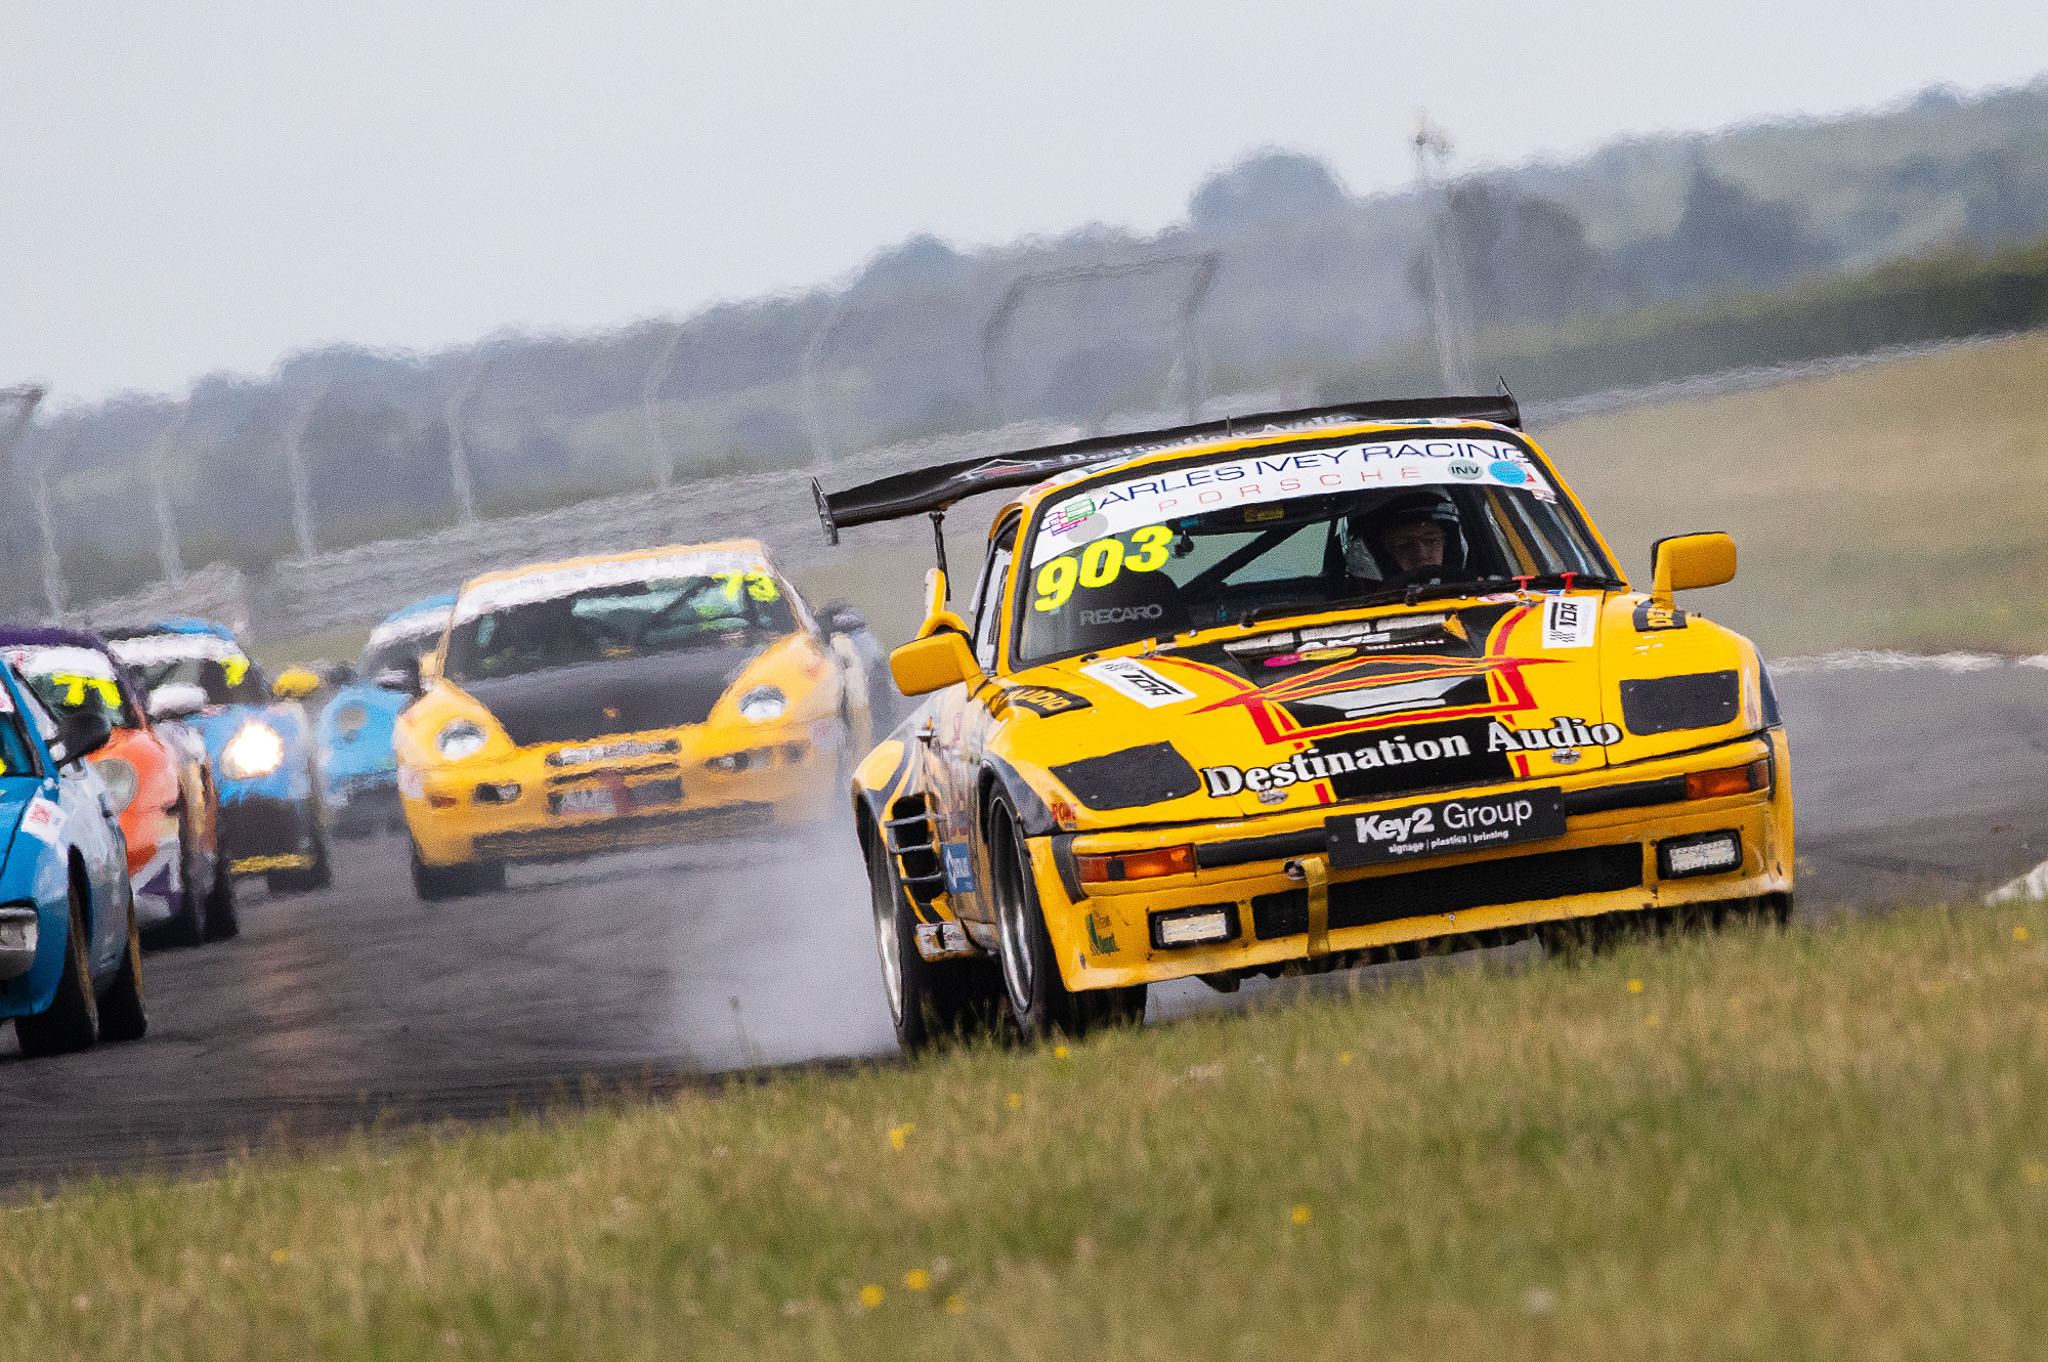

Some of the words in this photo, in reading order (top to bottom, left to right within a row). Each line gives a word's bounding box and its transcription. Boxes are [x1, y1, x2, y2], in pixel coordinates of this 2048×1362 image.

[1040, 466, 1245, 532] ARLES
[1256, 449, 1348, 475] IVEY
[1159, 466, 1422, 511] PORSCHE
[1451, 466, 1481, 475] INV
[1034, 526, 1173, 612] 903
[1079, 604, 1162, 626] RECARO
[1201, 733, 1471, 798] Destination
[1486, 717, 1624, 753] Audio
[1355, 807, 1435, 843] Key2
[1443, 800, 1533, 829] Group
[1388, 842, 1424, 855] signage
[1472, 830, 1510, 843] printing
